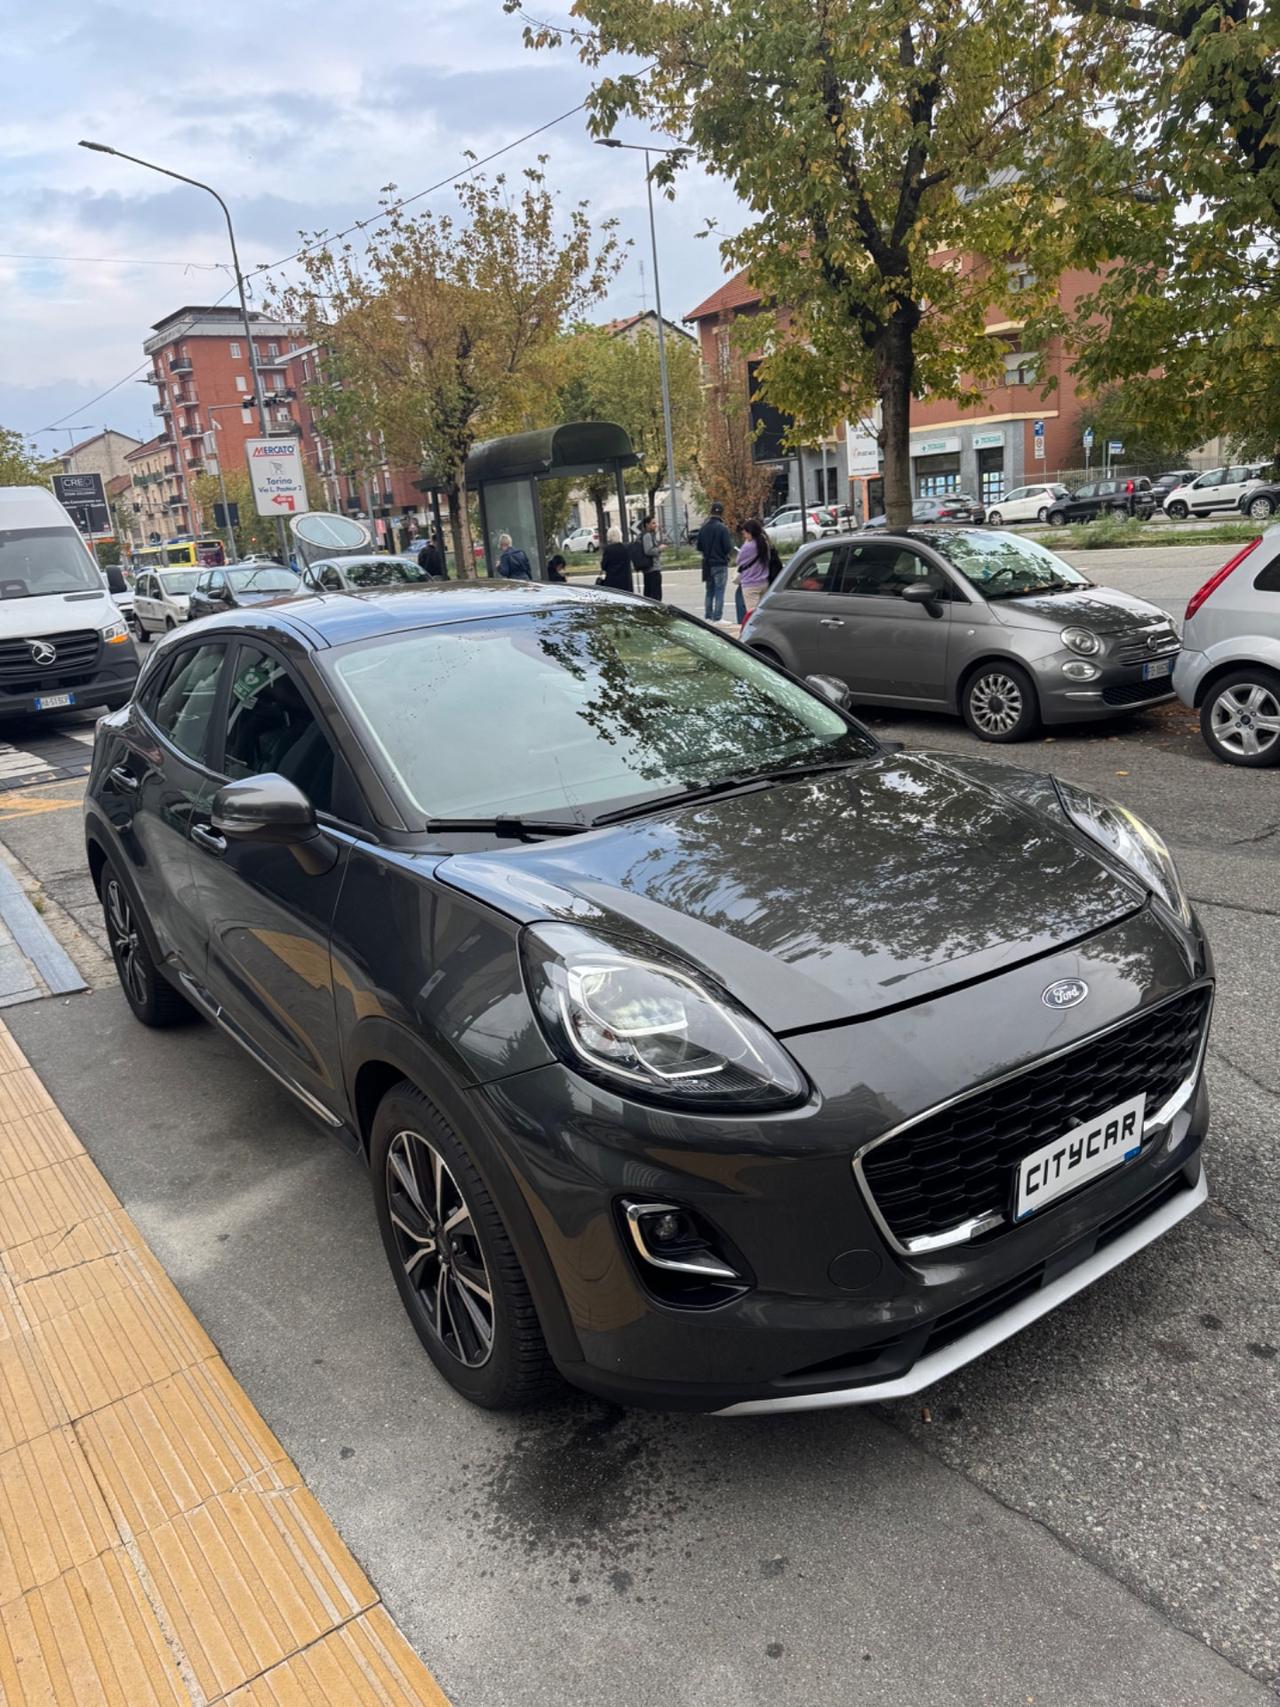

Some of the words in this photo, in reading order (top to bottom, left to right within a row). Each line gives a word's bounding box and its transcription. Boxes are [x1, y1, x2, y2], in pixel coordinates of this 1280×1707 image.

[253, 445, 295, 457] MERCATO
[266, 477, 293, 485] Torino
[1053, 985, 1080, 1004] Ford
[1026, 1110, 1136, 1196] CITYCAR
